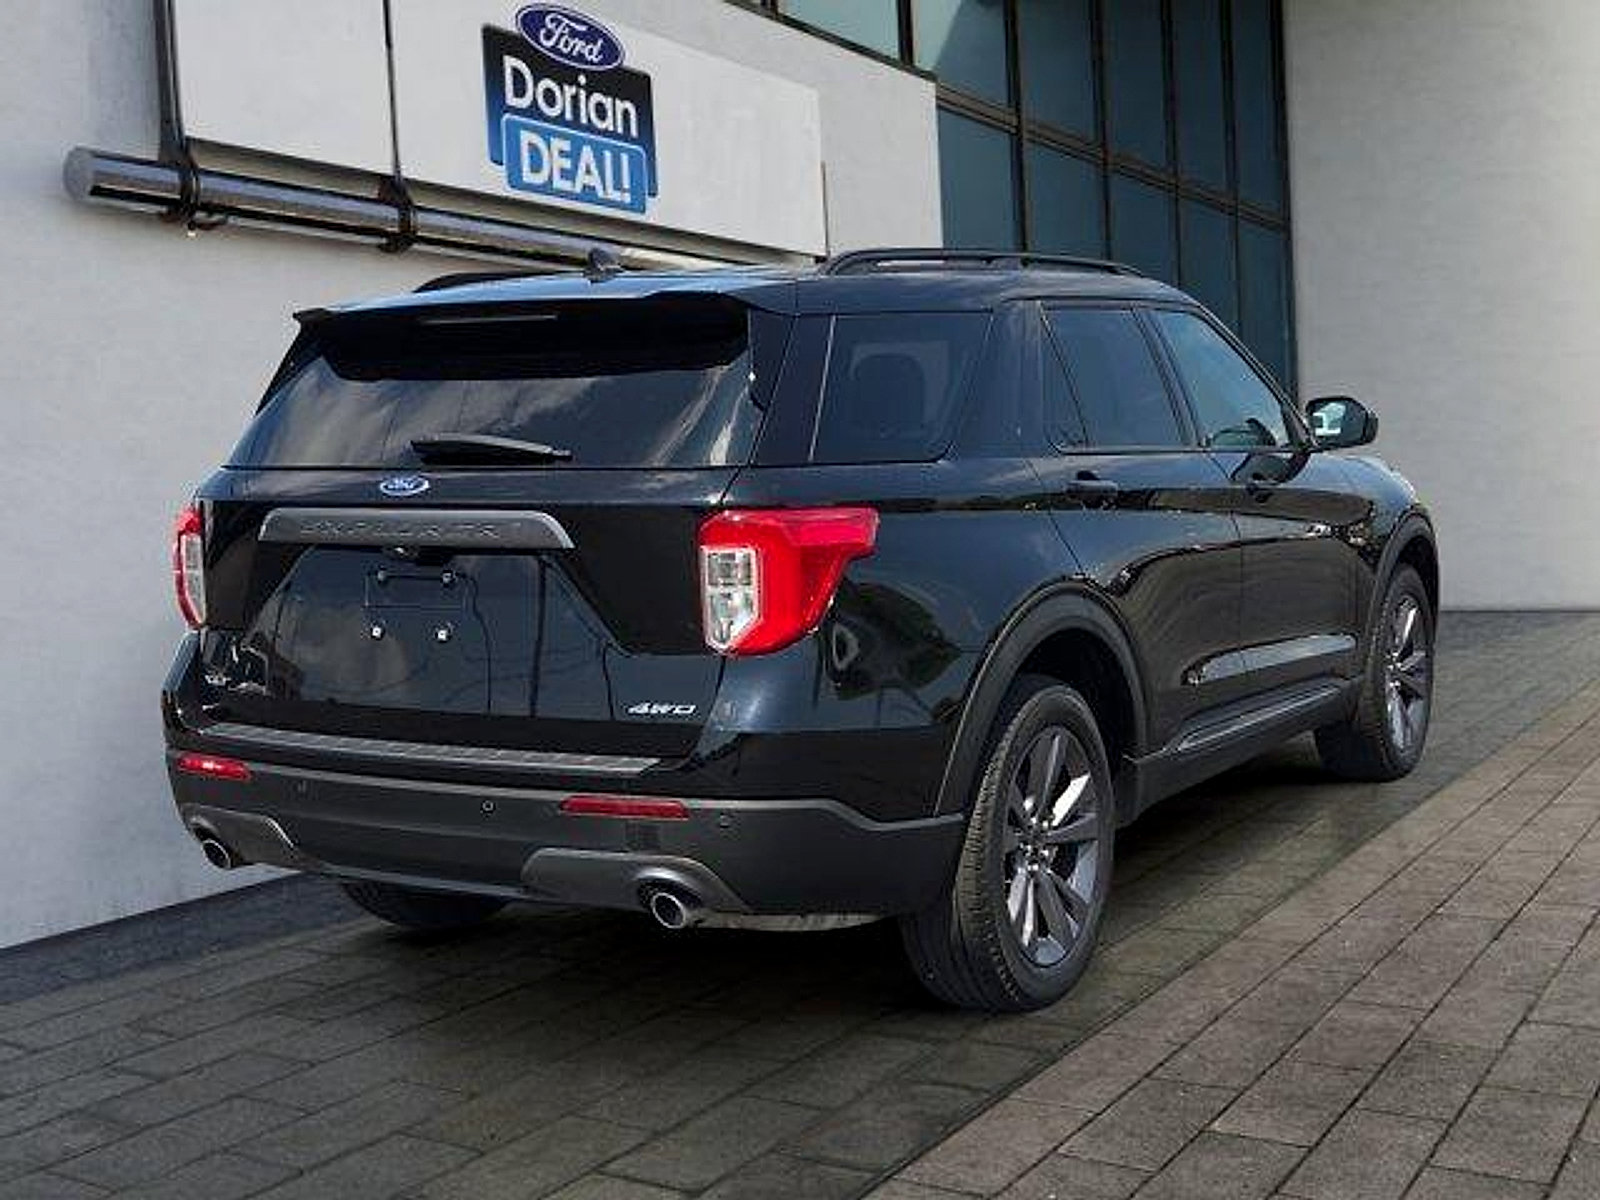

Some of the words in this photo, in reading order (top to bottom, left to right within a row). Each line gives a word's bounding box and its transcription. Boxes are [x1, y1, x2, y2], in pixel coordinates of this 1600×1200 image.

[539, 12, 604, 63] Ford
[502, 55, 638, 138] Dorian
[520, 130, 631, 204] DEAL!
[627, 702, 697, 715] 4WD
